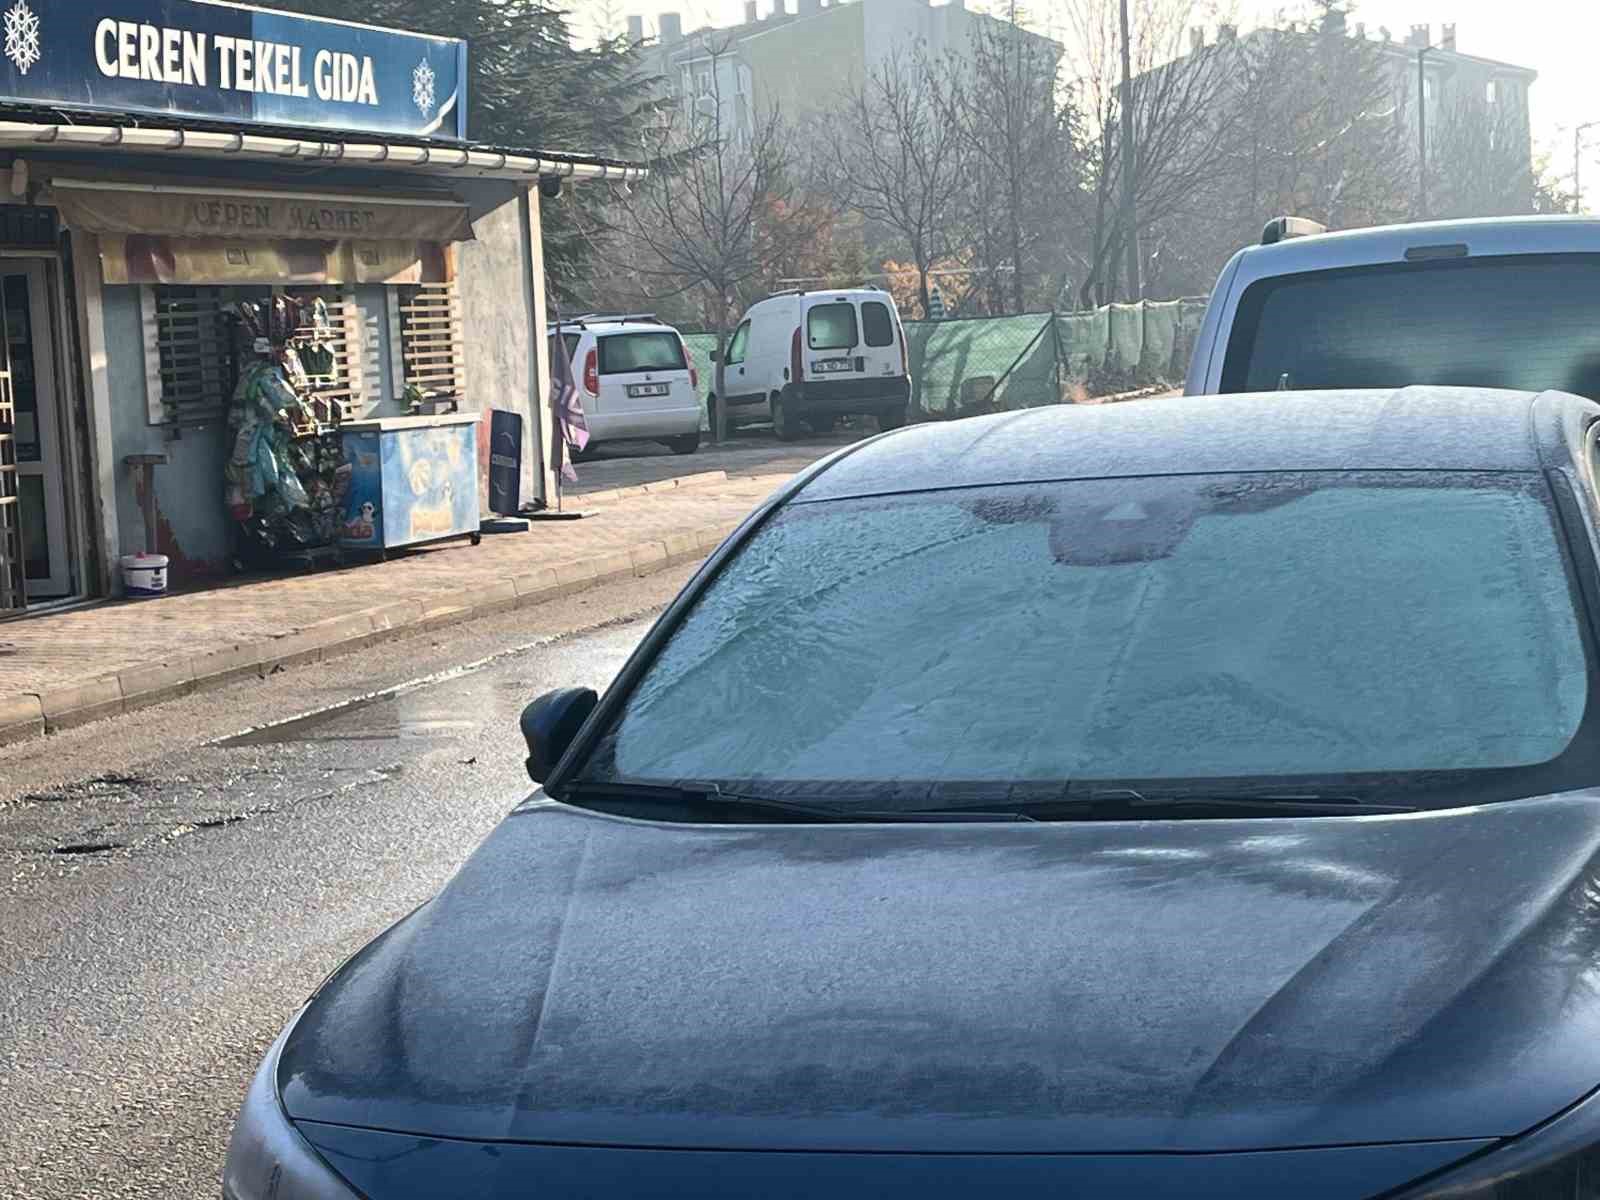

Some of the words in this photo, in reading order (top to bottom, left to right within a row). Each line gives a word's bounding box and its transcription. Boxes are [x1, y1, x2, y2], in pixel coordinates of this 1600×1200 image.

[94, 17, 207, 87] CEREN
[213, 35, 310, 98] TEKEL
[314, 49, 378, 105] GIDA
